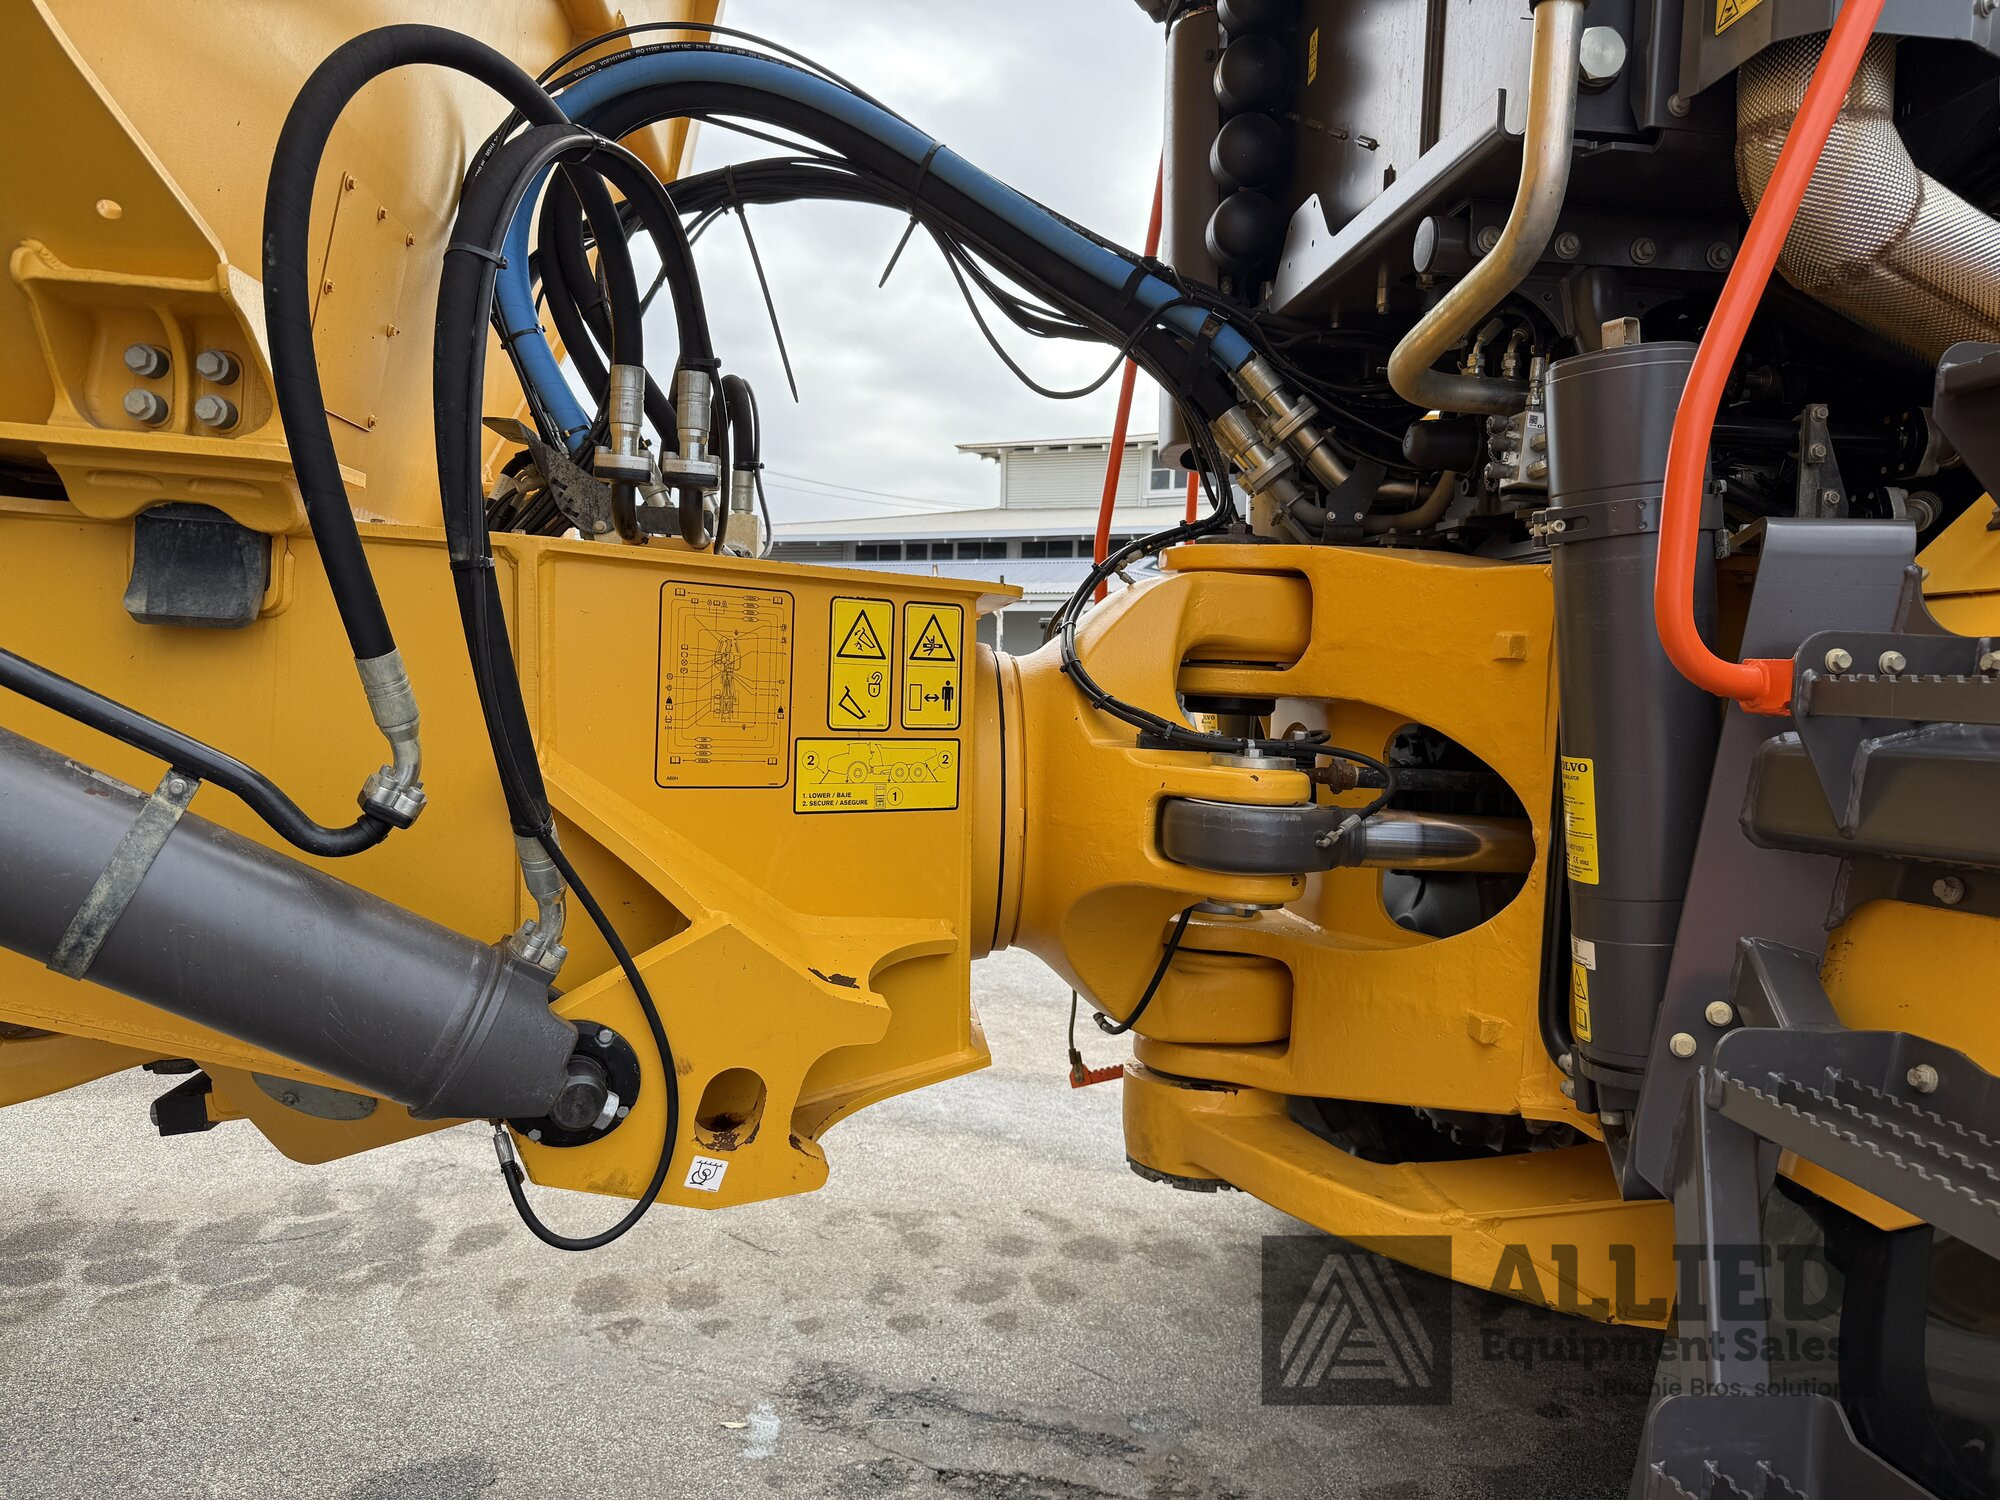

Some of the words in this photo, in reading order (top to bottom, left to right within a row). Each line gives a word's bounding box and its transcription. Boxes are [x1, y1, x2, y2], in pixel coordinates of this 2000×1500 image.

[573, 64, 596, 77] VOLVO
[806, 755, 815, 765] 2
[942, 754, 949, 765] 2
[892, 791, 898, 802] 1
